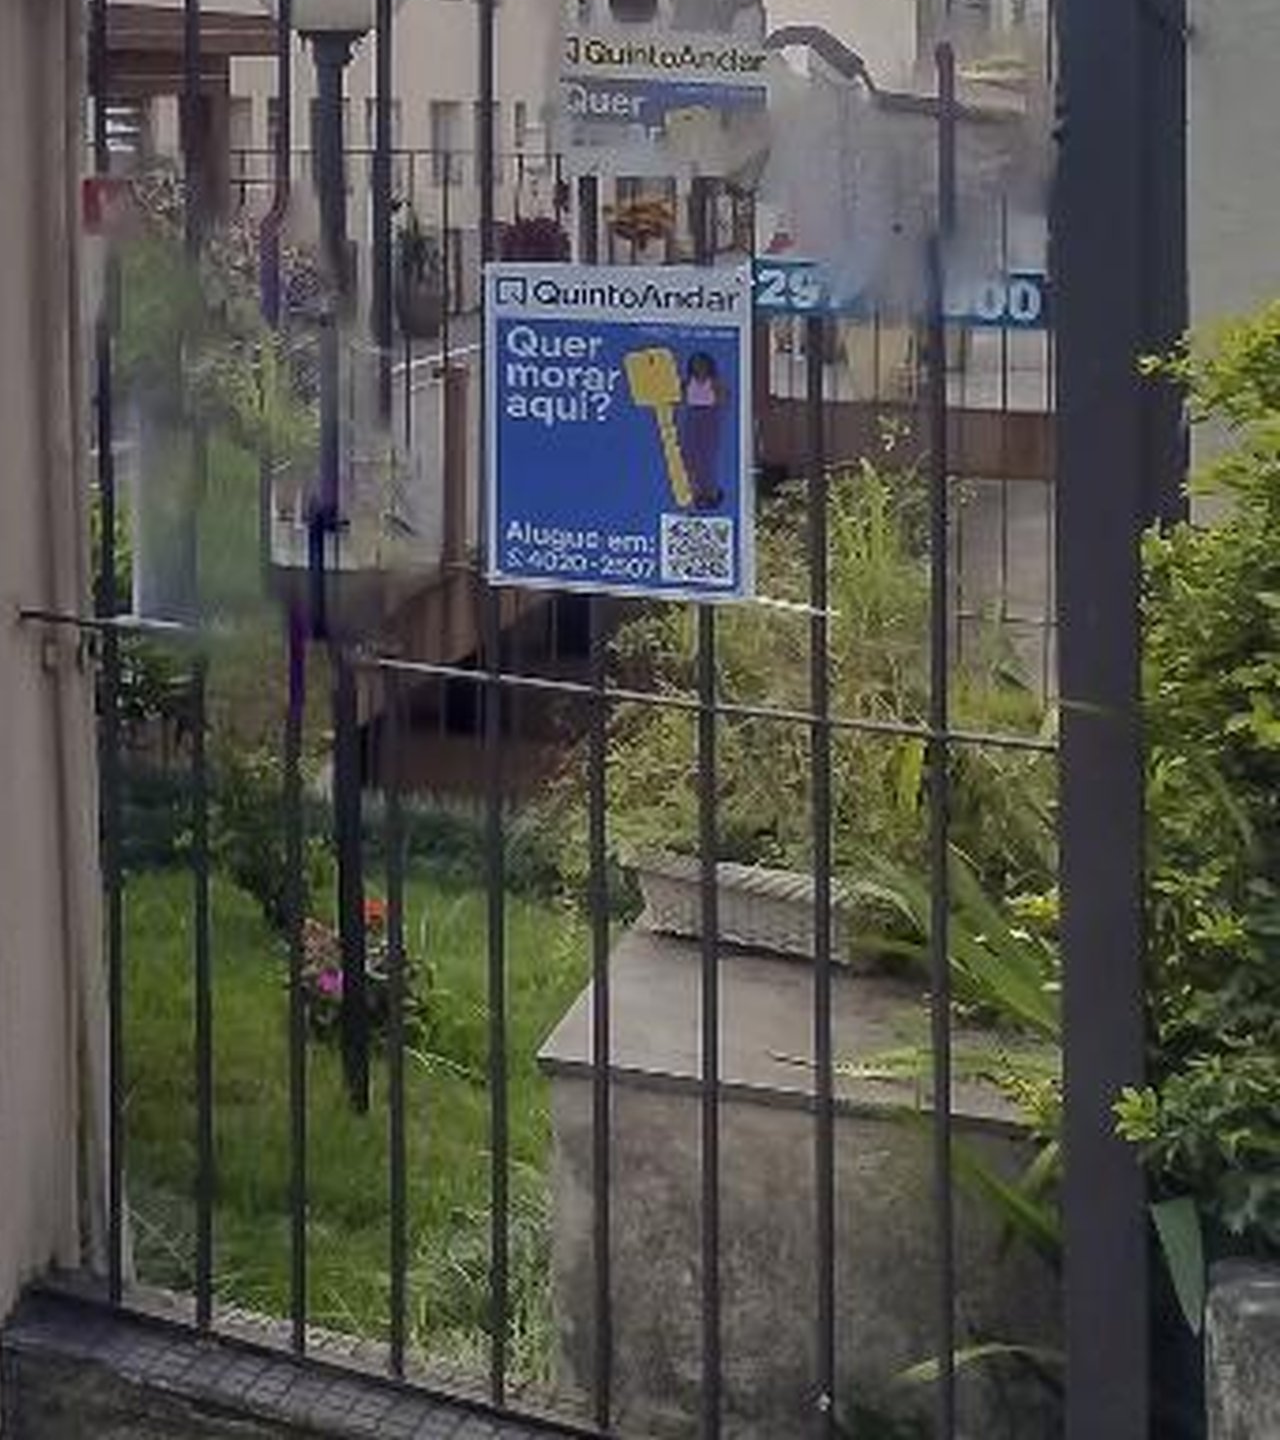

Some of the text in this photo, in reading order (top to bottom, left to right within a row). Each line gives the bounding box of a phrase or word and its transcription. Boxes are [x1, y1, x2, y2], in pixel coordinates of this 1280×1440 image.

[534, 280, 740, 311] QuintoAndar
[506, 325, 603, 358] Quer
[506, 361, 621, 391] morar
[506, 392, 612, 427] aqui?
